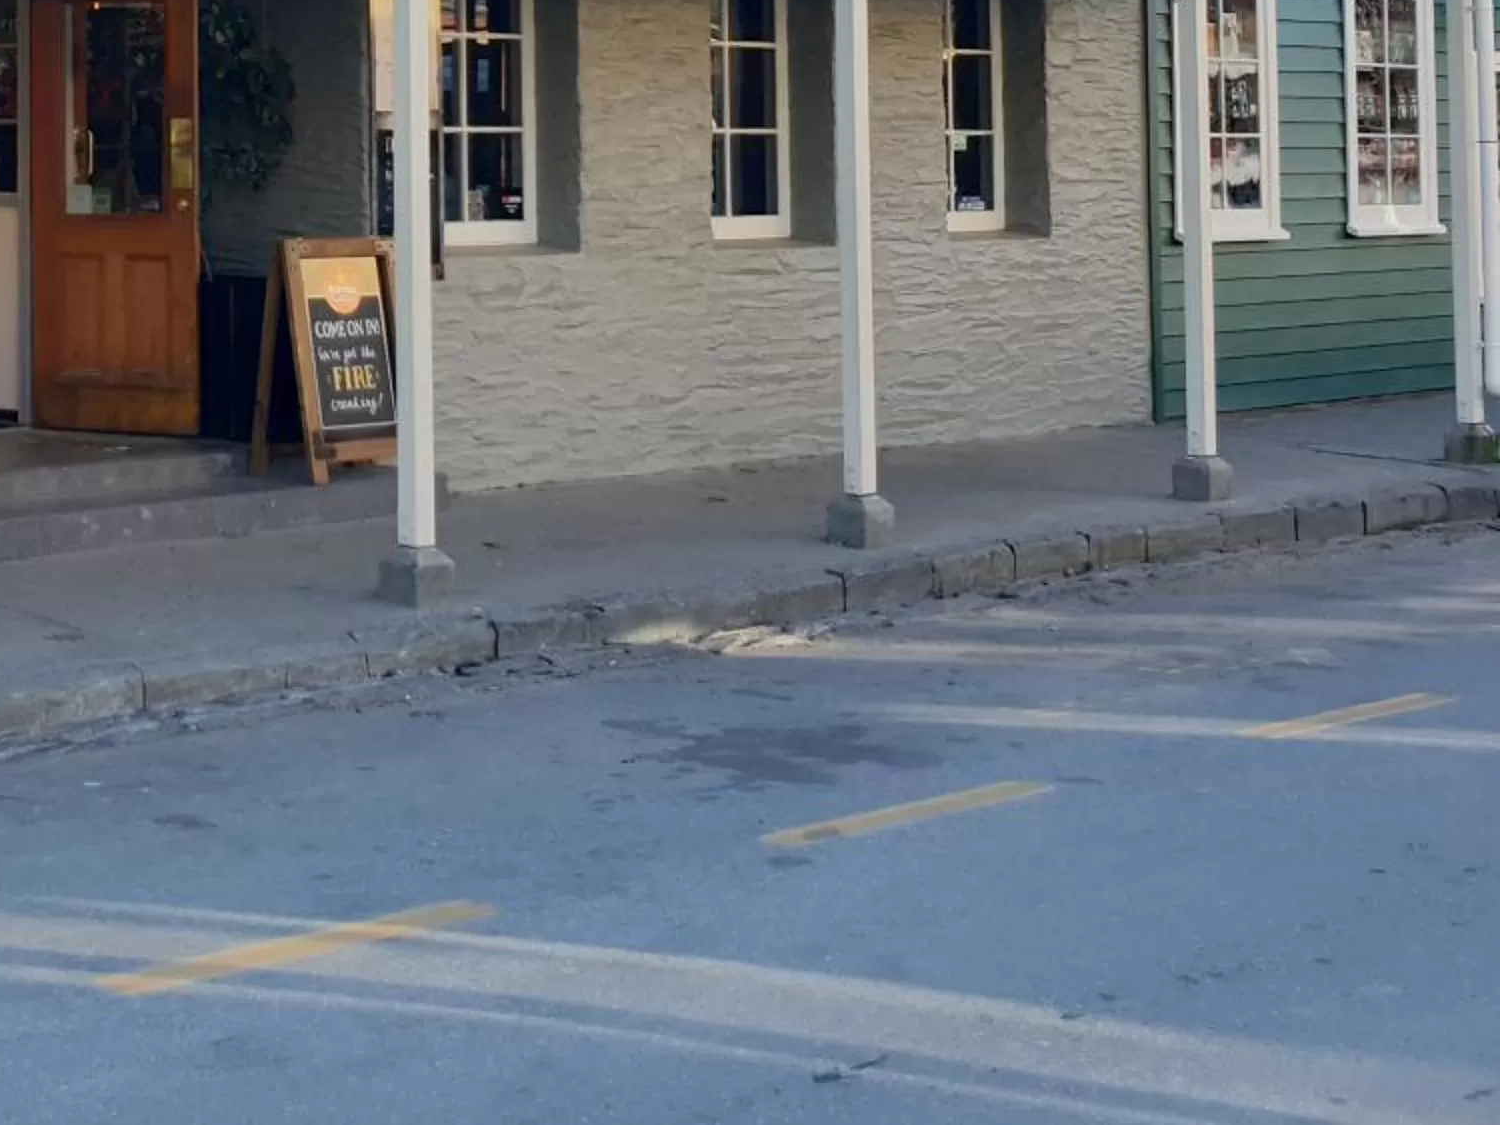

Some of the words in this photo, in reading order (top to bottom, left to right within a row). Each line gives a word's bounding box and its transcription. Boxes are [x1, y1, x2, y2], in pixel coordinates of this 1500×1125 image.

[315, 320, 347, 339] COME
[347, 320, 365, 337] ON
[332, 364, 377, 391] FIRE
